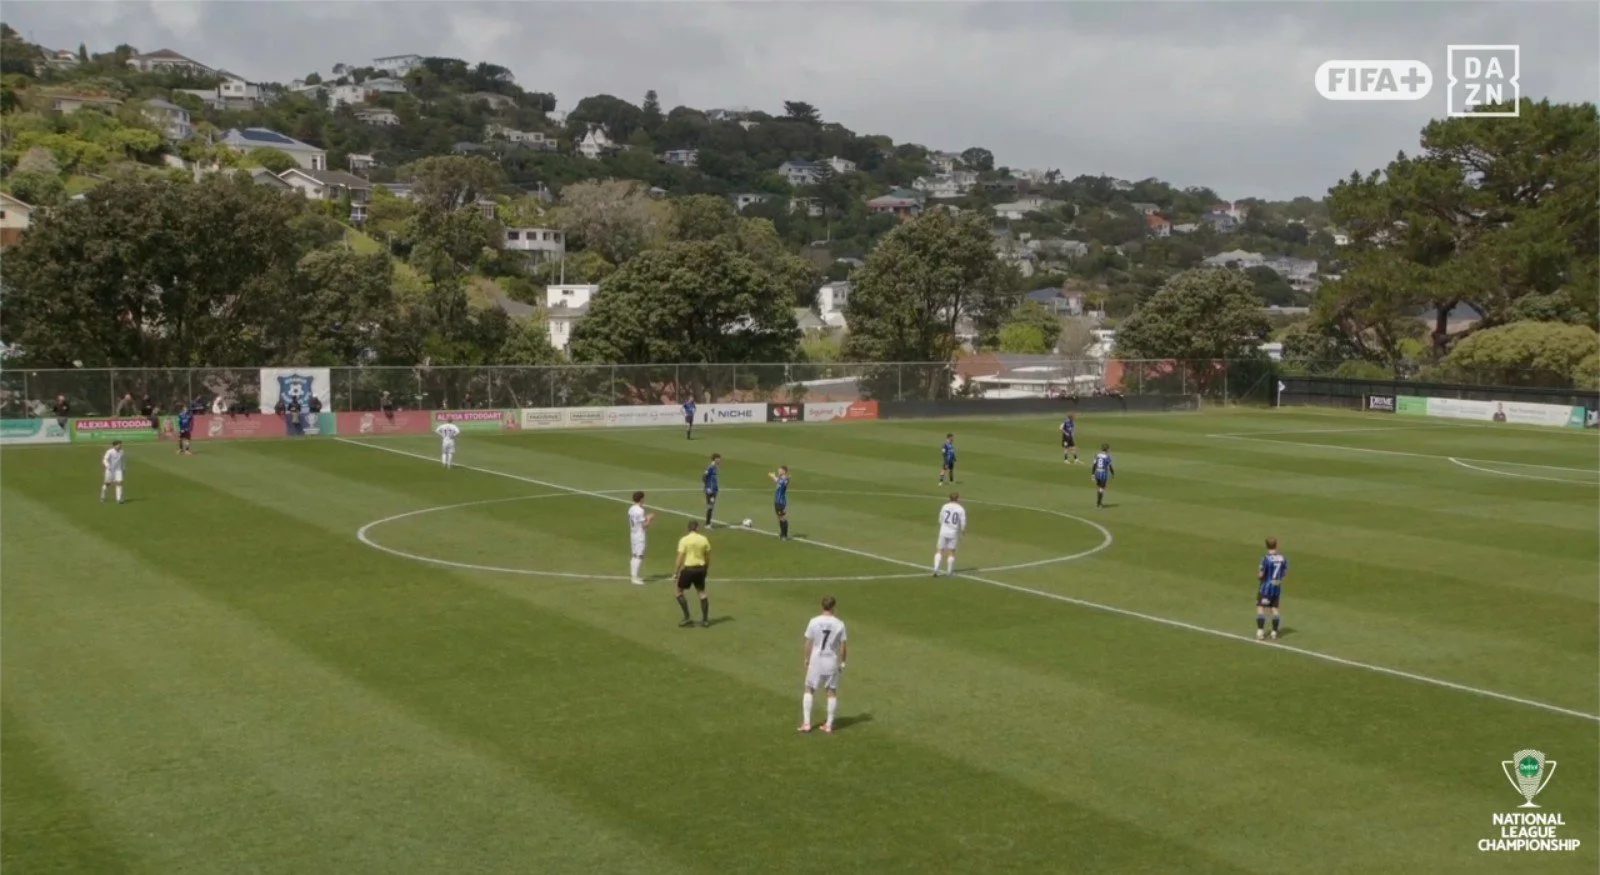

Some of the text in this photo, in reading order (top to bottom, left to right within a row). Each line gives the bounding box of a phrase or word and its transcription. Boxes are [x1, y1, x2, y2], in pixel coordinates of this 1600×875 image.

[111, 420, 152, 428] STODDAR
[944, 510, 960, 525] 20
[1272, 563, 1281, 579] 7
[821, 629, 832, 651] 7
